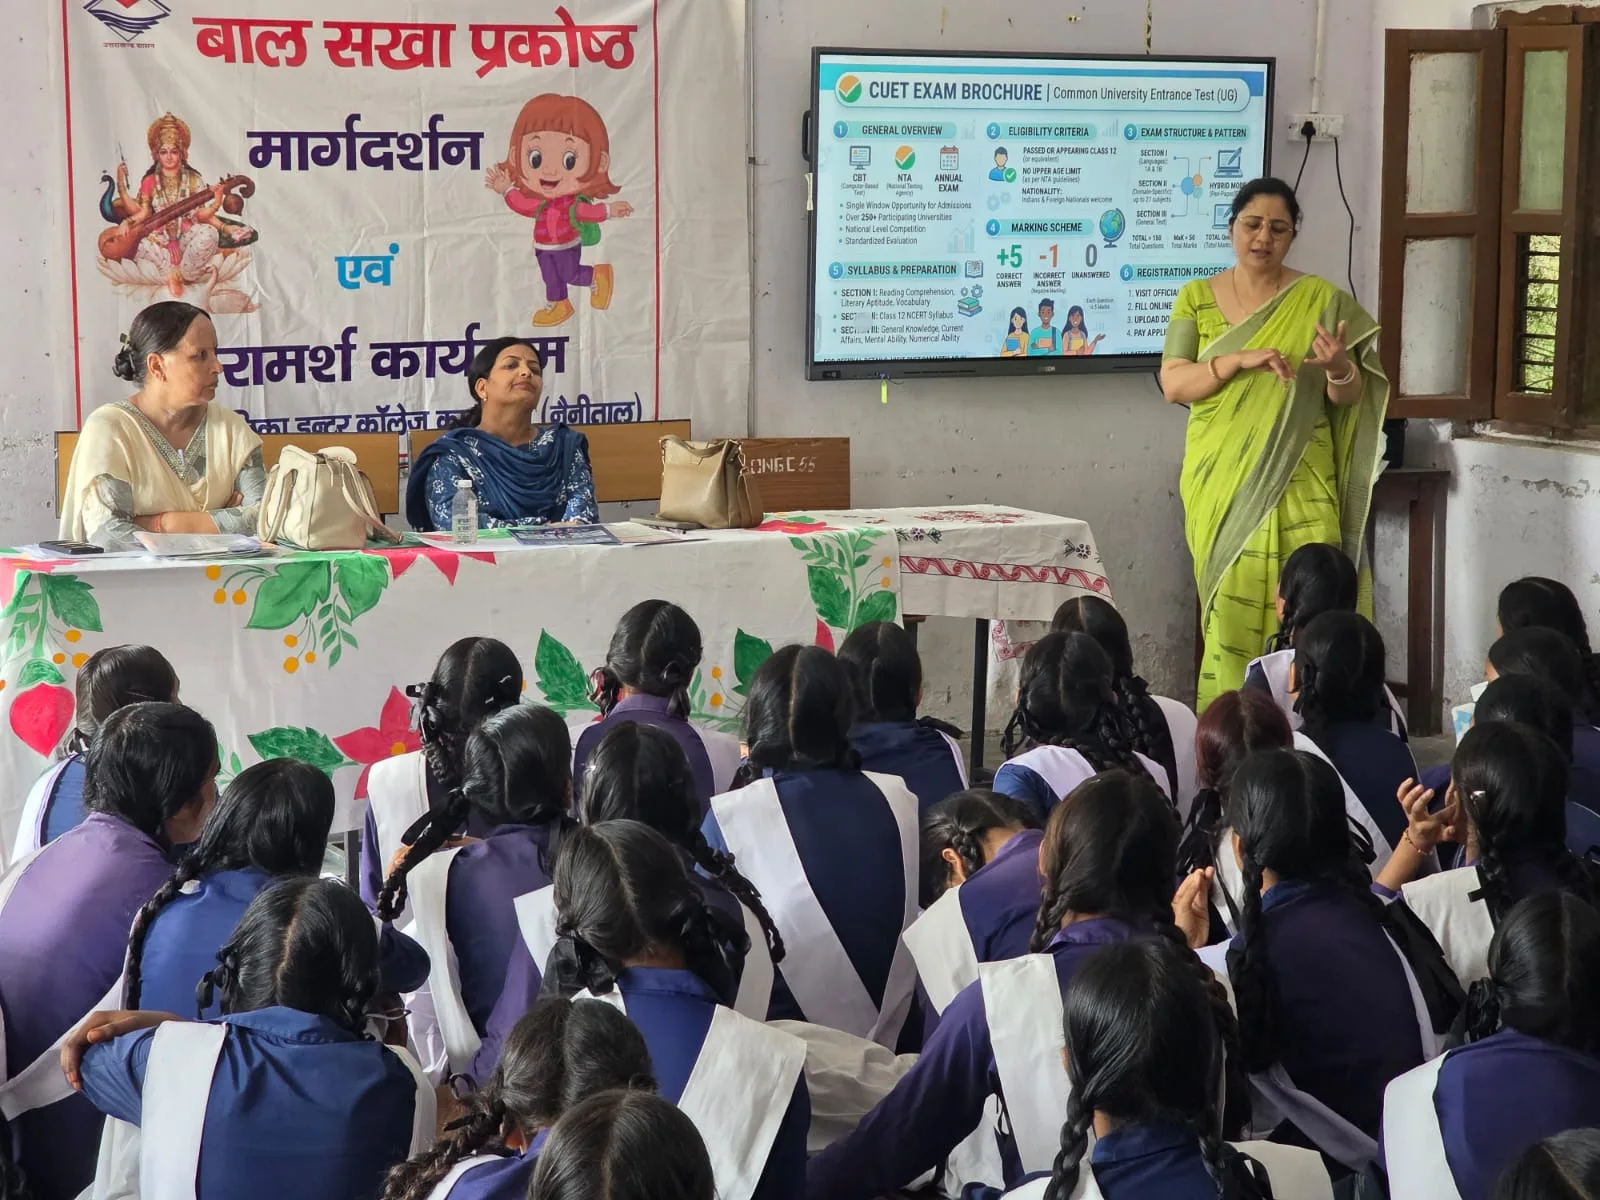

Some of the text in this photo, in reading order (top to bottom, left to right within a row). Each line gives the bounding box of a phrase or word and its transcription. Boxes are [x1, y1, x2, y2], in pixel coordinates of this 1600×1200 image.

[192, 5, 638, 79] बाल सखा प्रकोष्ठ
[869, 81, 1042, 101] CUET EXAM BROCHURE
[1053, 86, 1238, 104] Common University Entrance Test (UG)
[862, 125, 900, 135] GENERAL
[901, 125, 943, 136] OVERVIEW
[1008, 126, 1053, 137] ELIGIBILITY
[1054, 127, 1089, 137] CRITERIA
[1141, 128, 1162, 137] EXAM
[1163, 128, 1206, 137] STRUCTURE
[1208, 129, 1213, 137] &
[1214, 128, 1247, 138] PATTERN
[246, 113, 485, 172] मार्गदर्शन
[1023, 147, 1117, 155] PASSED OR APPEARING CLASS 12
[1140, 149, 1165, 157] SECTION
[1022, 167, 1082, 175] NO UPPER AGE LIMIT
[852, 173, 867, 182] CBT
[897, 174, 912, 182] NTA
[934, 174, 963, 183] ANNUAL
[938, 184, 959, 192] EXAM
[845, 201, 972, 211] Single Window Opportunity for Admissions
[878, 214, 916, 223] Participating
[1136, 210, 1161, 218] SECTION
[889, 226, 926, 235] Competition
[1011, 223, 1048, 233] MARKING
[1049, 222, 1083, 232] SCHEME
[996, 244, 1023, 268] +5
[1039, 244, 1058, 268] -1
[1085, 243, 1098, 268] 0
[334, 242, 400, 290] एवं
[847, 265, 891, 276] SYLLABUS
[893, 265, 898, 274] &
[901, 264, 957, 275] PREPARATION
[996, 272, 1023, 280] CORRECT
[1033, 271, 1066, 279] INCORRECT
[1071, 271, 1111, 279] UNANSWERED
[1137, 267, 1192, 277] REGISTRATION
[997, 280, 1022, 288] ANSWER
[841, 288, 872, 297] SECTION
[879, 288, 905, 298] Reading
[1135, 289, 1152, 297] VISIT
[1153, 288, 1180, 297] OFFICIA
[841, 299, 865, 309] Literary
[896, 298, 931, 308] Vocabulary
[1127, 302, 1173, 311] 2. FILL ONLINE
[879, 311, 896, 320] Class
[898, 311, 905, 320] 12
[906, 311, 927, 320] NCERT
[928, 310, 954, 320] Syllabus
[1134, 315, 1160, 324] UPLOAD
[880, 325, 905, 333] General
[941, 324, 964, 333] Current
[1126, 329, 1134, 337] 4.
[1133, 329, 1146, 337] PAY
[864, 336, 886, 344] Mental
[909, 334, 939, 343] Numerical
[940, 333, 961, 343] Ability
[215, 326, 358, 388] रामर्श
